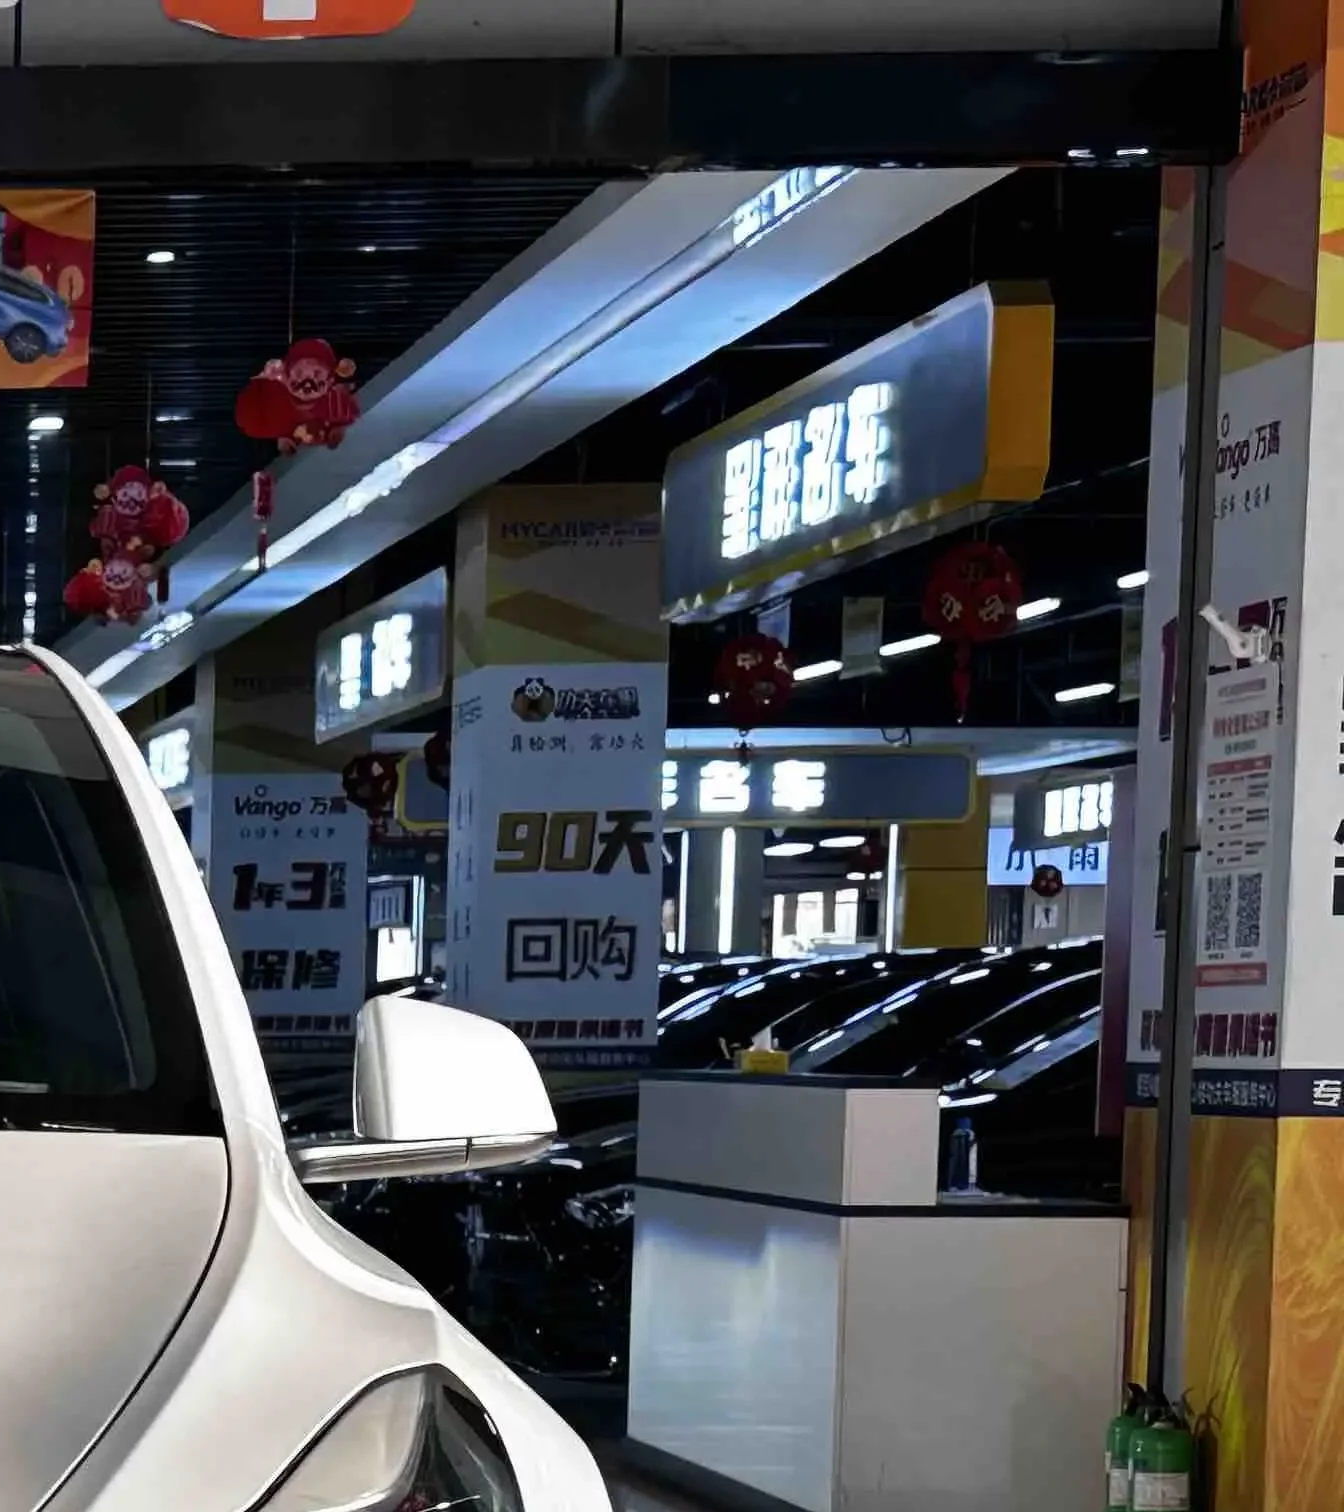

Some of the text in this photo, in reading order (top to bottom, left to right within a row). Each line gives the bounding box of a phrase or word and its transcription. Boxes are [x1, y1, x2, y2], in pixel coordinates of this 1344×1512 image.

[662, 760, 827, 813] 名车
[493, 810, 655, 875] 90天
[241, 948, 341, 991] 保修
[505, 915, 638, 983] 回购
